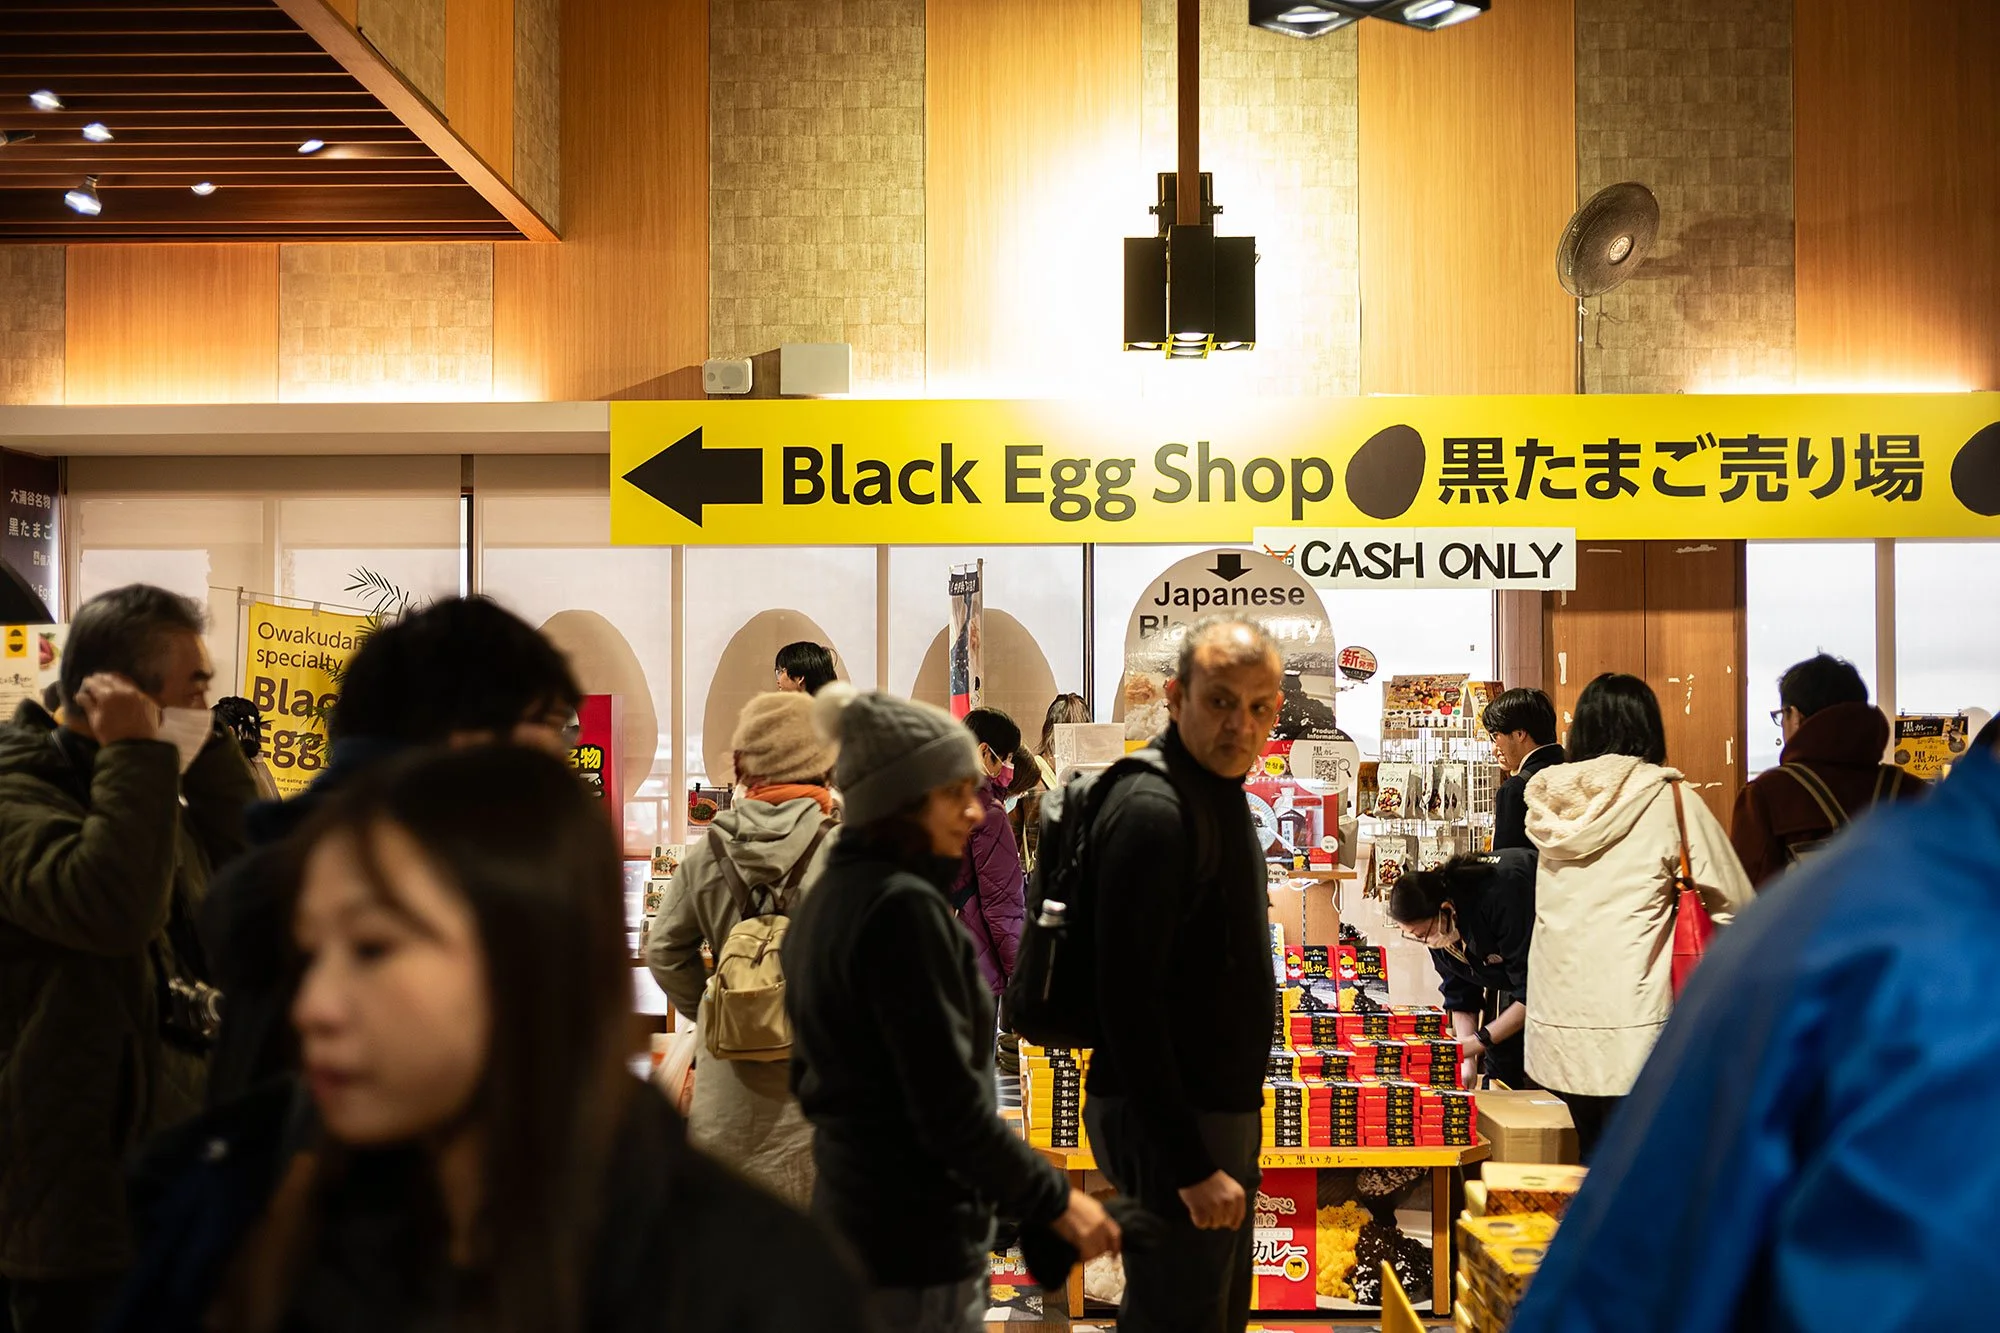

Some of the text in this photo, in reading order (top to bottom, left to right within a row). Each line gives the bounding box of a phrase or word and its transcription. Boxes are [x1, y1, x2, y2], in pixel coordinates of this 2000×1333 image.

[783, 441, 1334, 522] Black Egg Shop
[1438, 432, 1925, 505] 黒たまご売り場
[1301, 540, 1564, 581] CASH ONLY
[1154, 581, 1305, 612] Japanese
[257, 621, 368, 651] Owakudan
[256, 648, 344, 677] specialty
[253, 675, 341, 717] Blac
[1312, 727, 1338, 735] Product
[1913, 750, 1949, 763] 黒カレー
[1253, 1240, 1305, 1261] カレー
